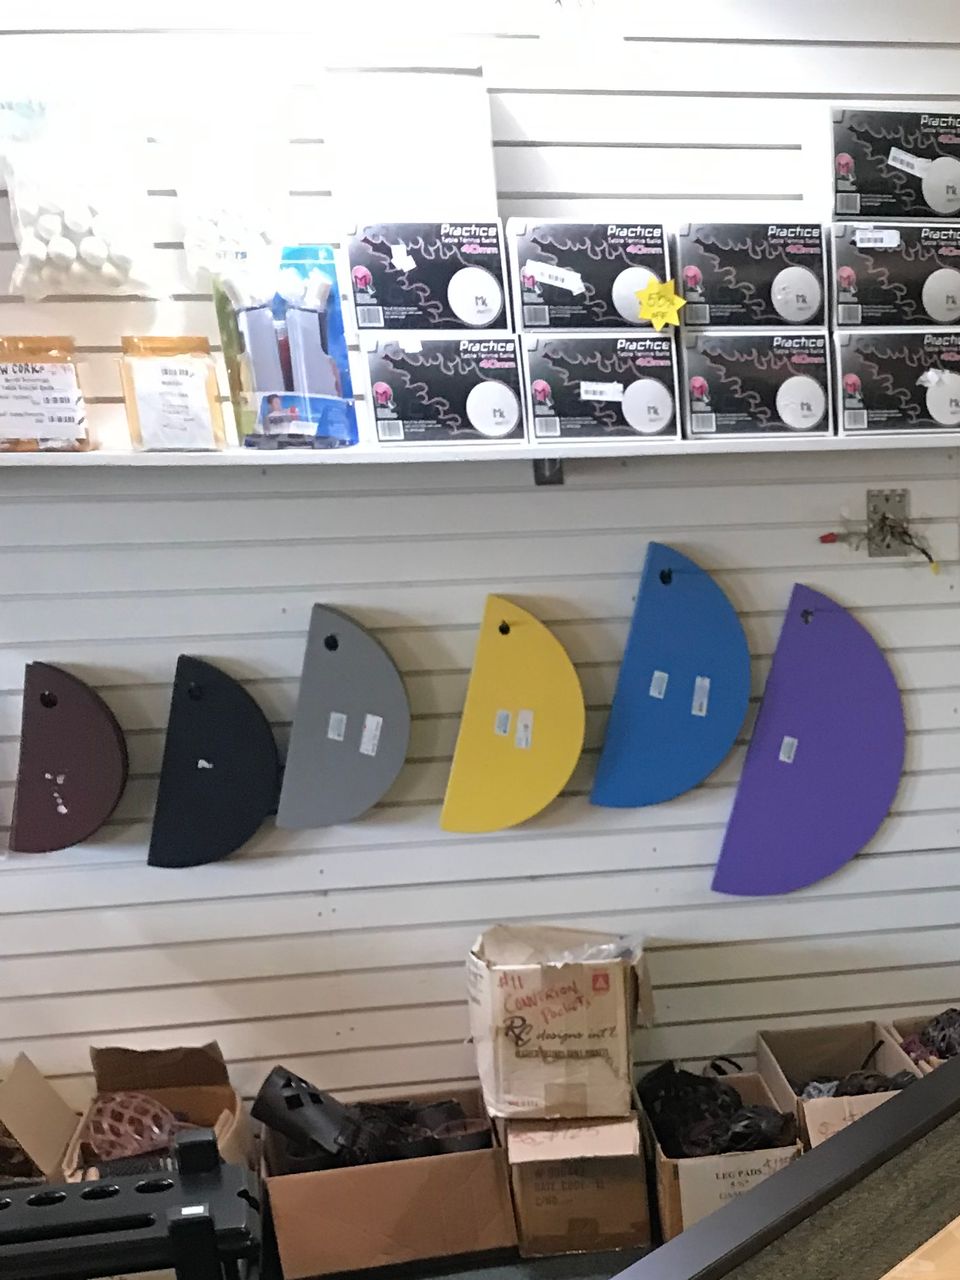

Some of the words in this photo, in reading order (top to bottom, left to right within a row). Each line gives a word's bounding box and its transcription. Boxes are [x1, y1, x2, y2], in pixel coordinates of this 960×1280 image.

[441, 224, 497, 236] Practice
[607, 224, 662, 237] Practice
[768, 226, 820, 236] Practice
[460, 340, 515, 352] Practice
[616, 340, 670, 350] Practice
[773, 337, 825, 348] Practice
[715, 1172, 736, 1180] LEG
[738, 1168, 762, 1178] PADS
